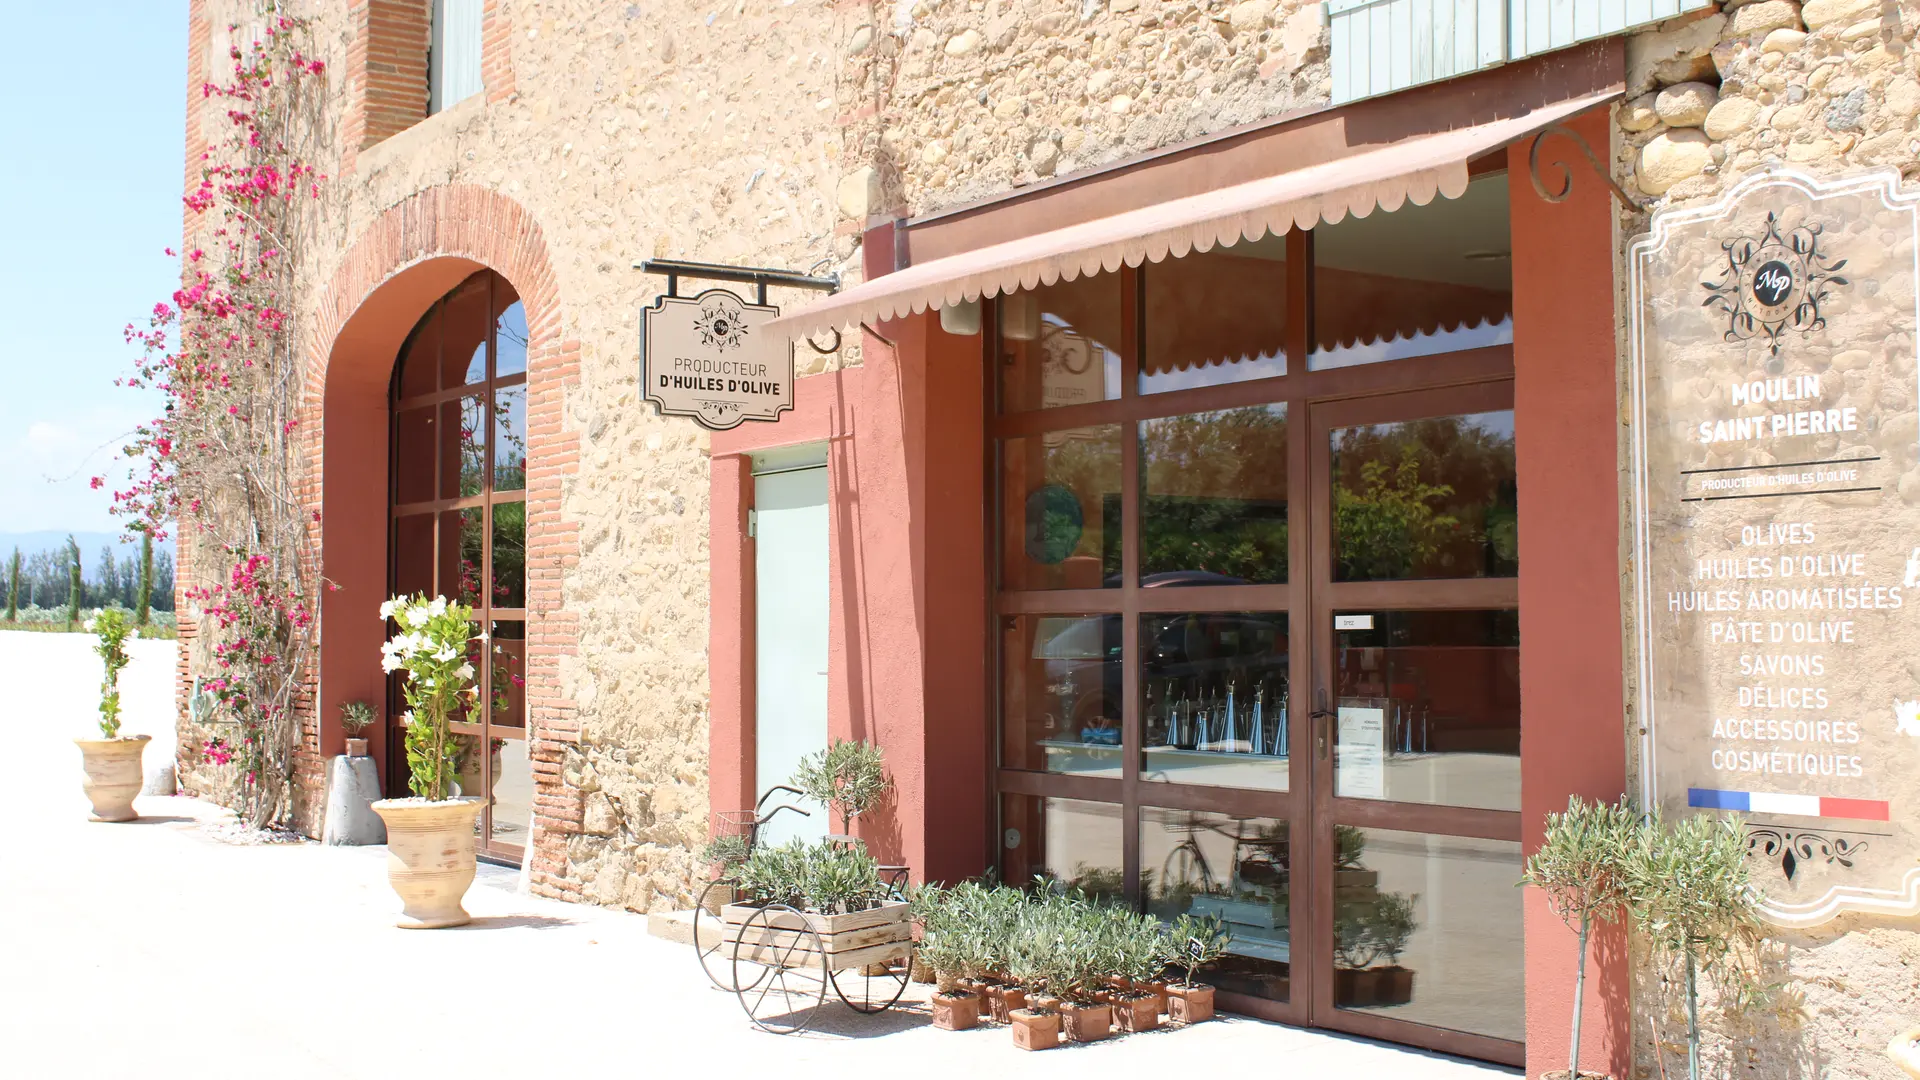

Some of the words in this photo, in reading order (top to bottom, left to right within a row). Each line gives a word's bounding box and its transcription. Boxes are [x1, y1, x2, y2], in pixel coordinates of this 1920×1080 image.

[674, 357, 767, 377] PRODUCTEUR
[660, 374, 724, 392] D'HUILES
[728, 379, 780, 396] D'OLIVE
[1732, 375, 1820, 406] MOULIN
[1700, 417, 1767, 444] SAINT
[1771, 407, 1857, 438] PIERRE
[1701, 475, 1766, 491] PRODUCTEUR
[1768, 472, 1815, 487] D'HUILES
[1817, 469, 1857, 484] D'OLIVE
[1741, 522, 1816, 547] OLIVES
[1699, 557, 1773, 580] HUILES
[1780, 553, 1865, 578] D'OLIVE
[1668, 590, 1740, 613] HUILES
[1747, 581, 1903, 612] AROMATISÉES
[1711, 618, 1764, 643] PÂTE
[1770, 620, 1854, 643] D'OLIVE
[1739, 654, 1825, 676] SAVONS
[1739, 682, 1828, 709] DÉLICES
[1712, 718, 1860, 744] ACCESSOIRES
[1711, 746, 1863, 778] COSMÉTIQUES
